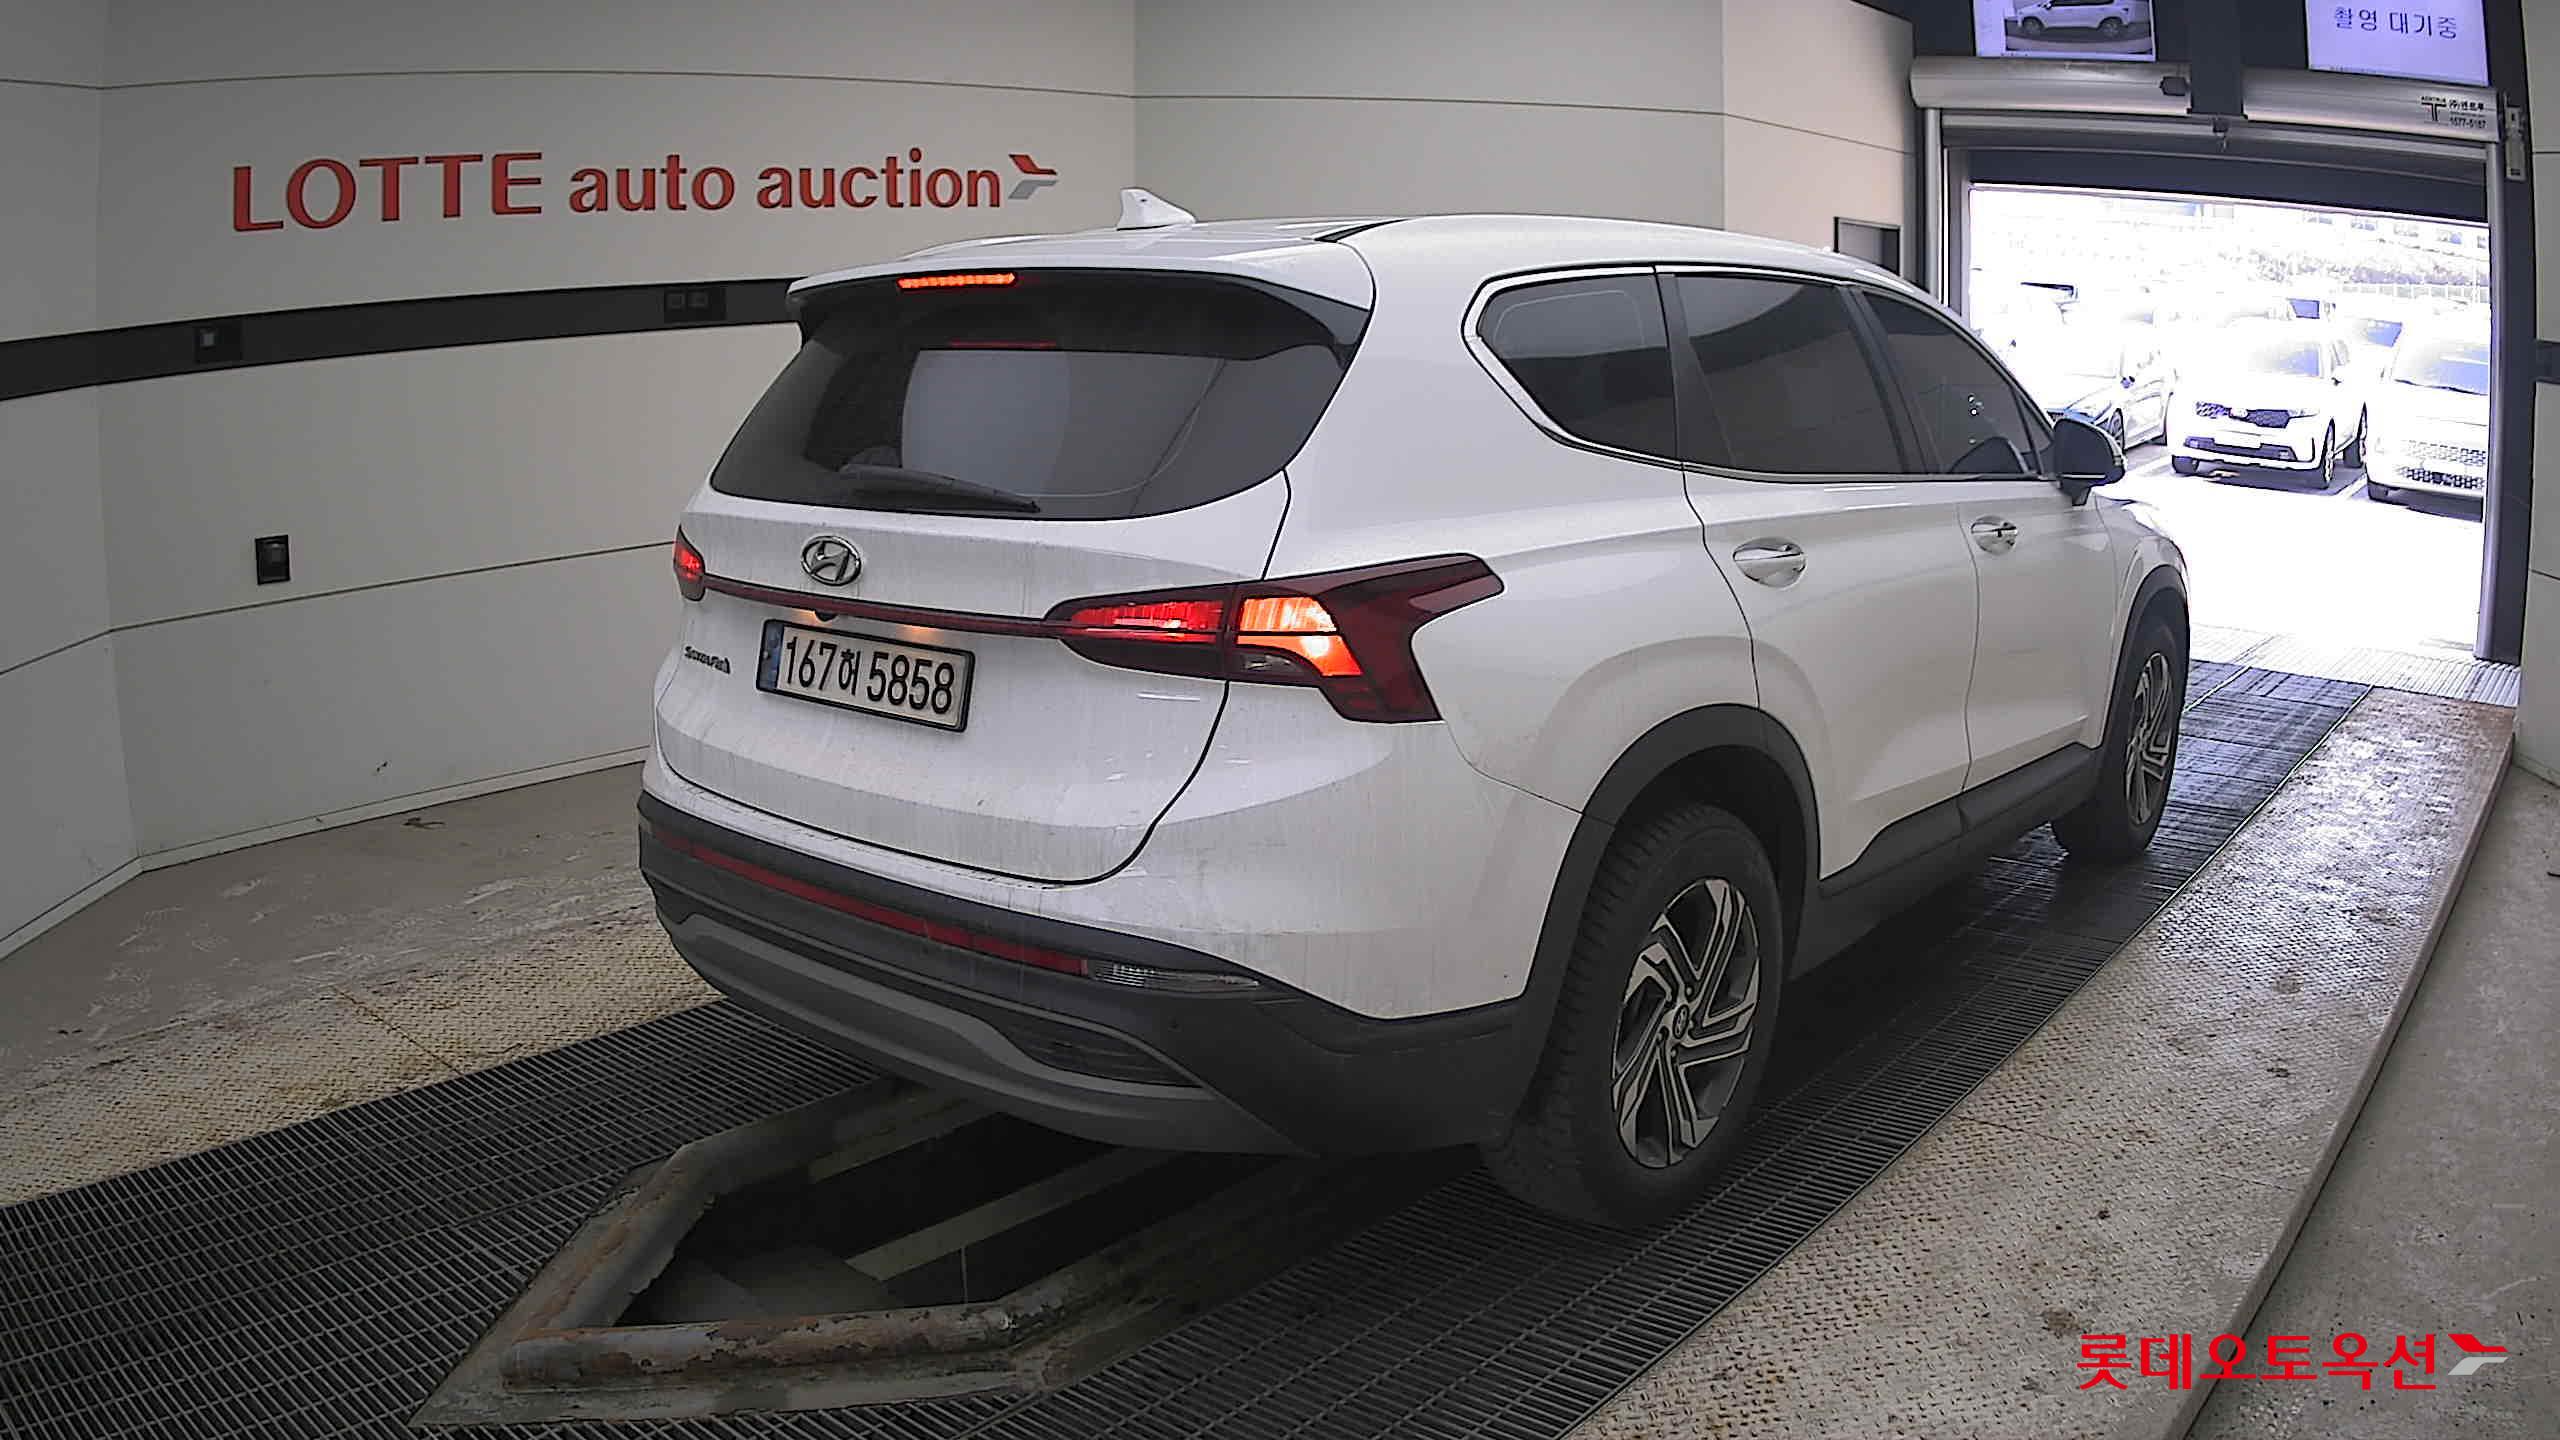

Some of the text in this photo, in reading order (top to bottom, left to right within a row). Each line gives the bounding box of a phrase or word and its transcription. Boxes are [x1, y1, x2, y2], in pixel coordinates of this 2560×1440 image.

[2335, 6, 2457, 40] 촬영 대기중
[233, 147, 1001, 231] LOTTE auto auction
[786, 635, 955, 715] 167허 5858
